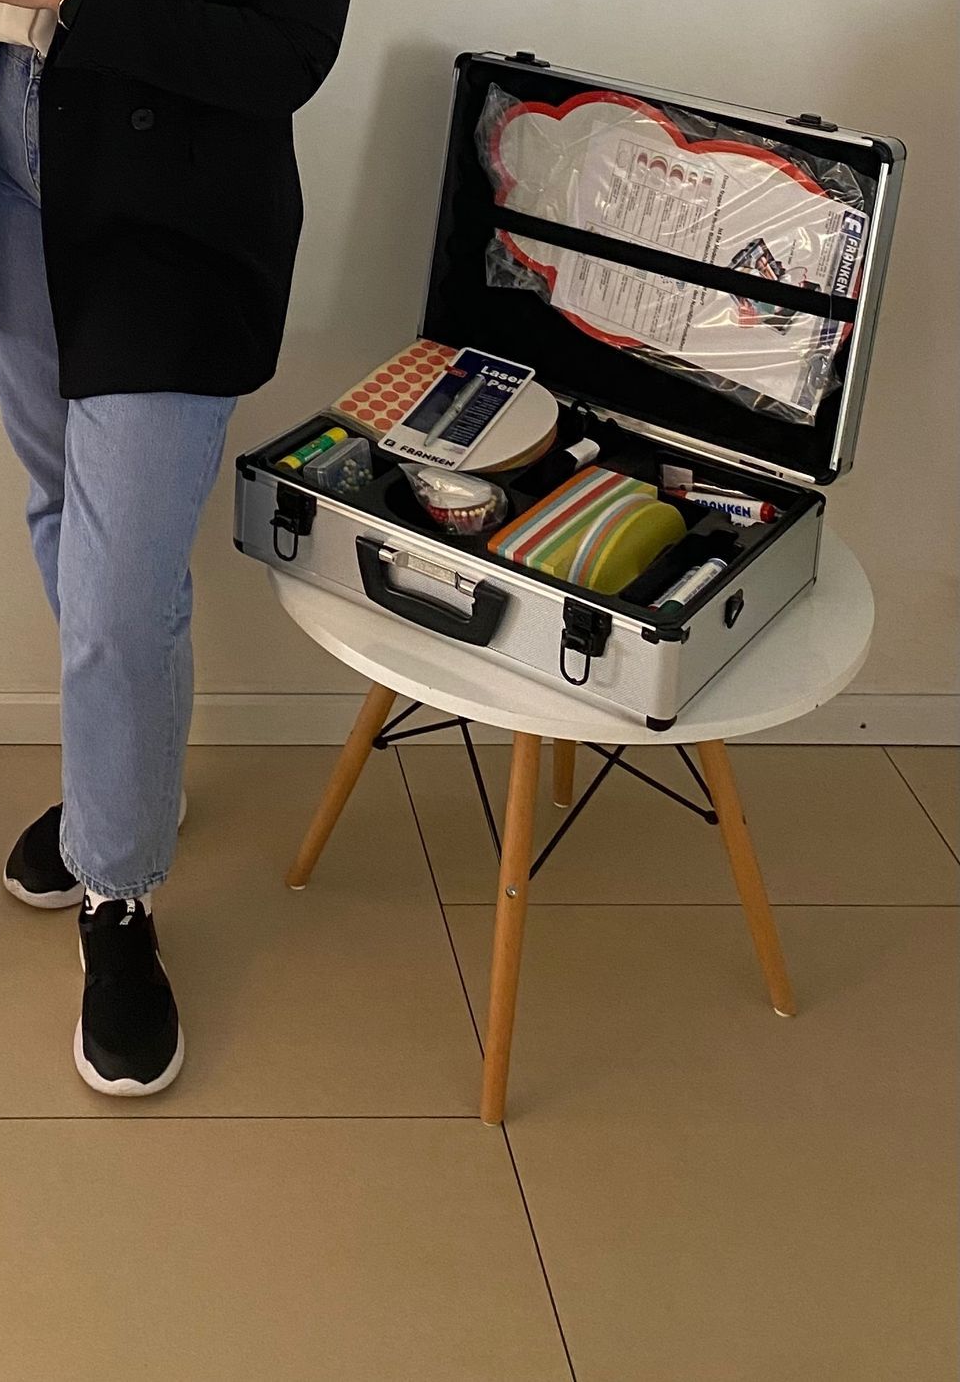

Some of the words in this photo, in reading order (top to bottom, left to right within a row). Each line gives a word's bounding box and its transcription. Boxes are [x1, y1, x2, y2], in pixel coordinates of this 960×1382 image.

[834, 237, 859, 294] FRANKEN
[480, 365, 525, 385] Laser
[399, 445, 456, 467] FRANKEN
